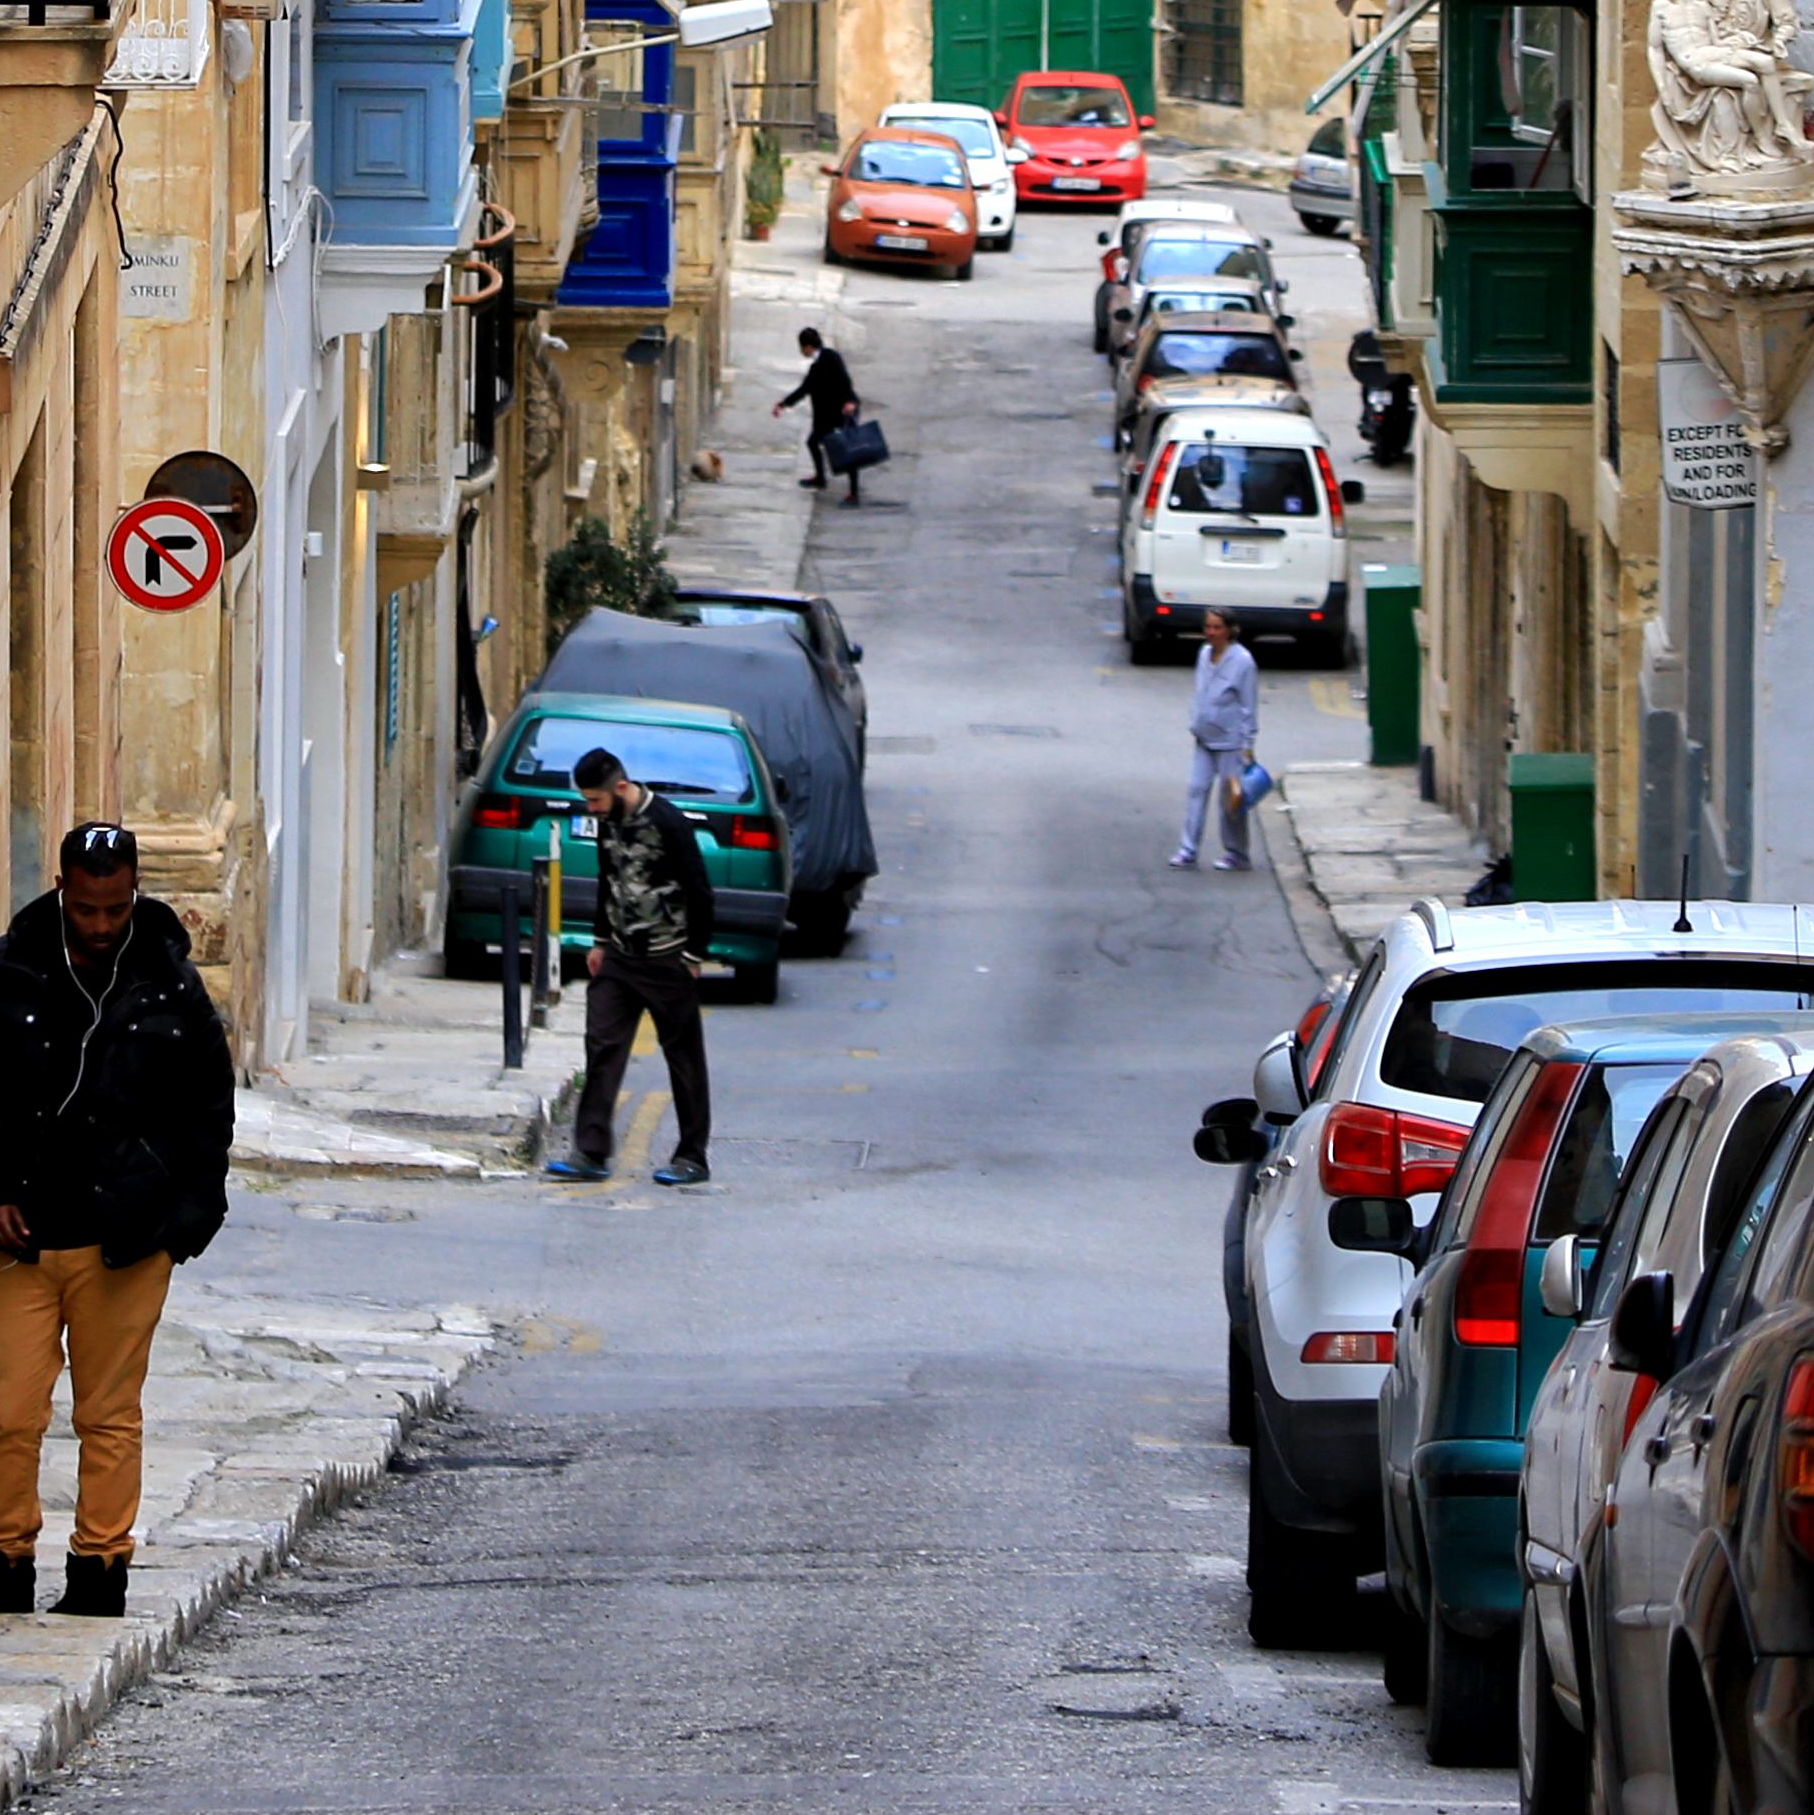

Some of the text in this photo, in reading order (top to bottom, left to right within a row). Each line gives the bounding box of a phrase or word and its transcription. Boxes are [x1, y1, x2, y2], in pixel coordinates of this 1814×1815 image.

[130, 285, 177, 298] STREET
[1668, 424, 1746, 442] EXCEPT FO
[1674, 443, 1752, 462] RESIDENTS
[1683, 463, 1745, 482] AND FOR
